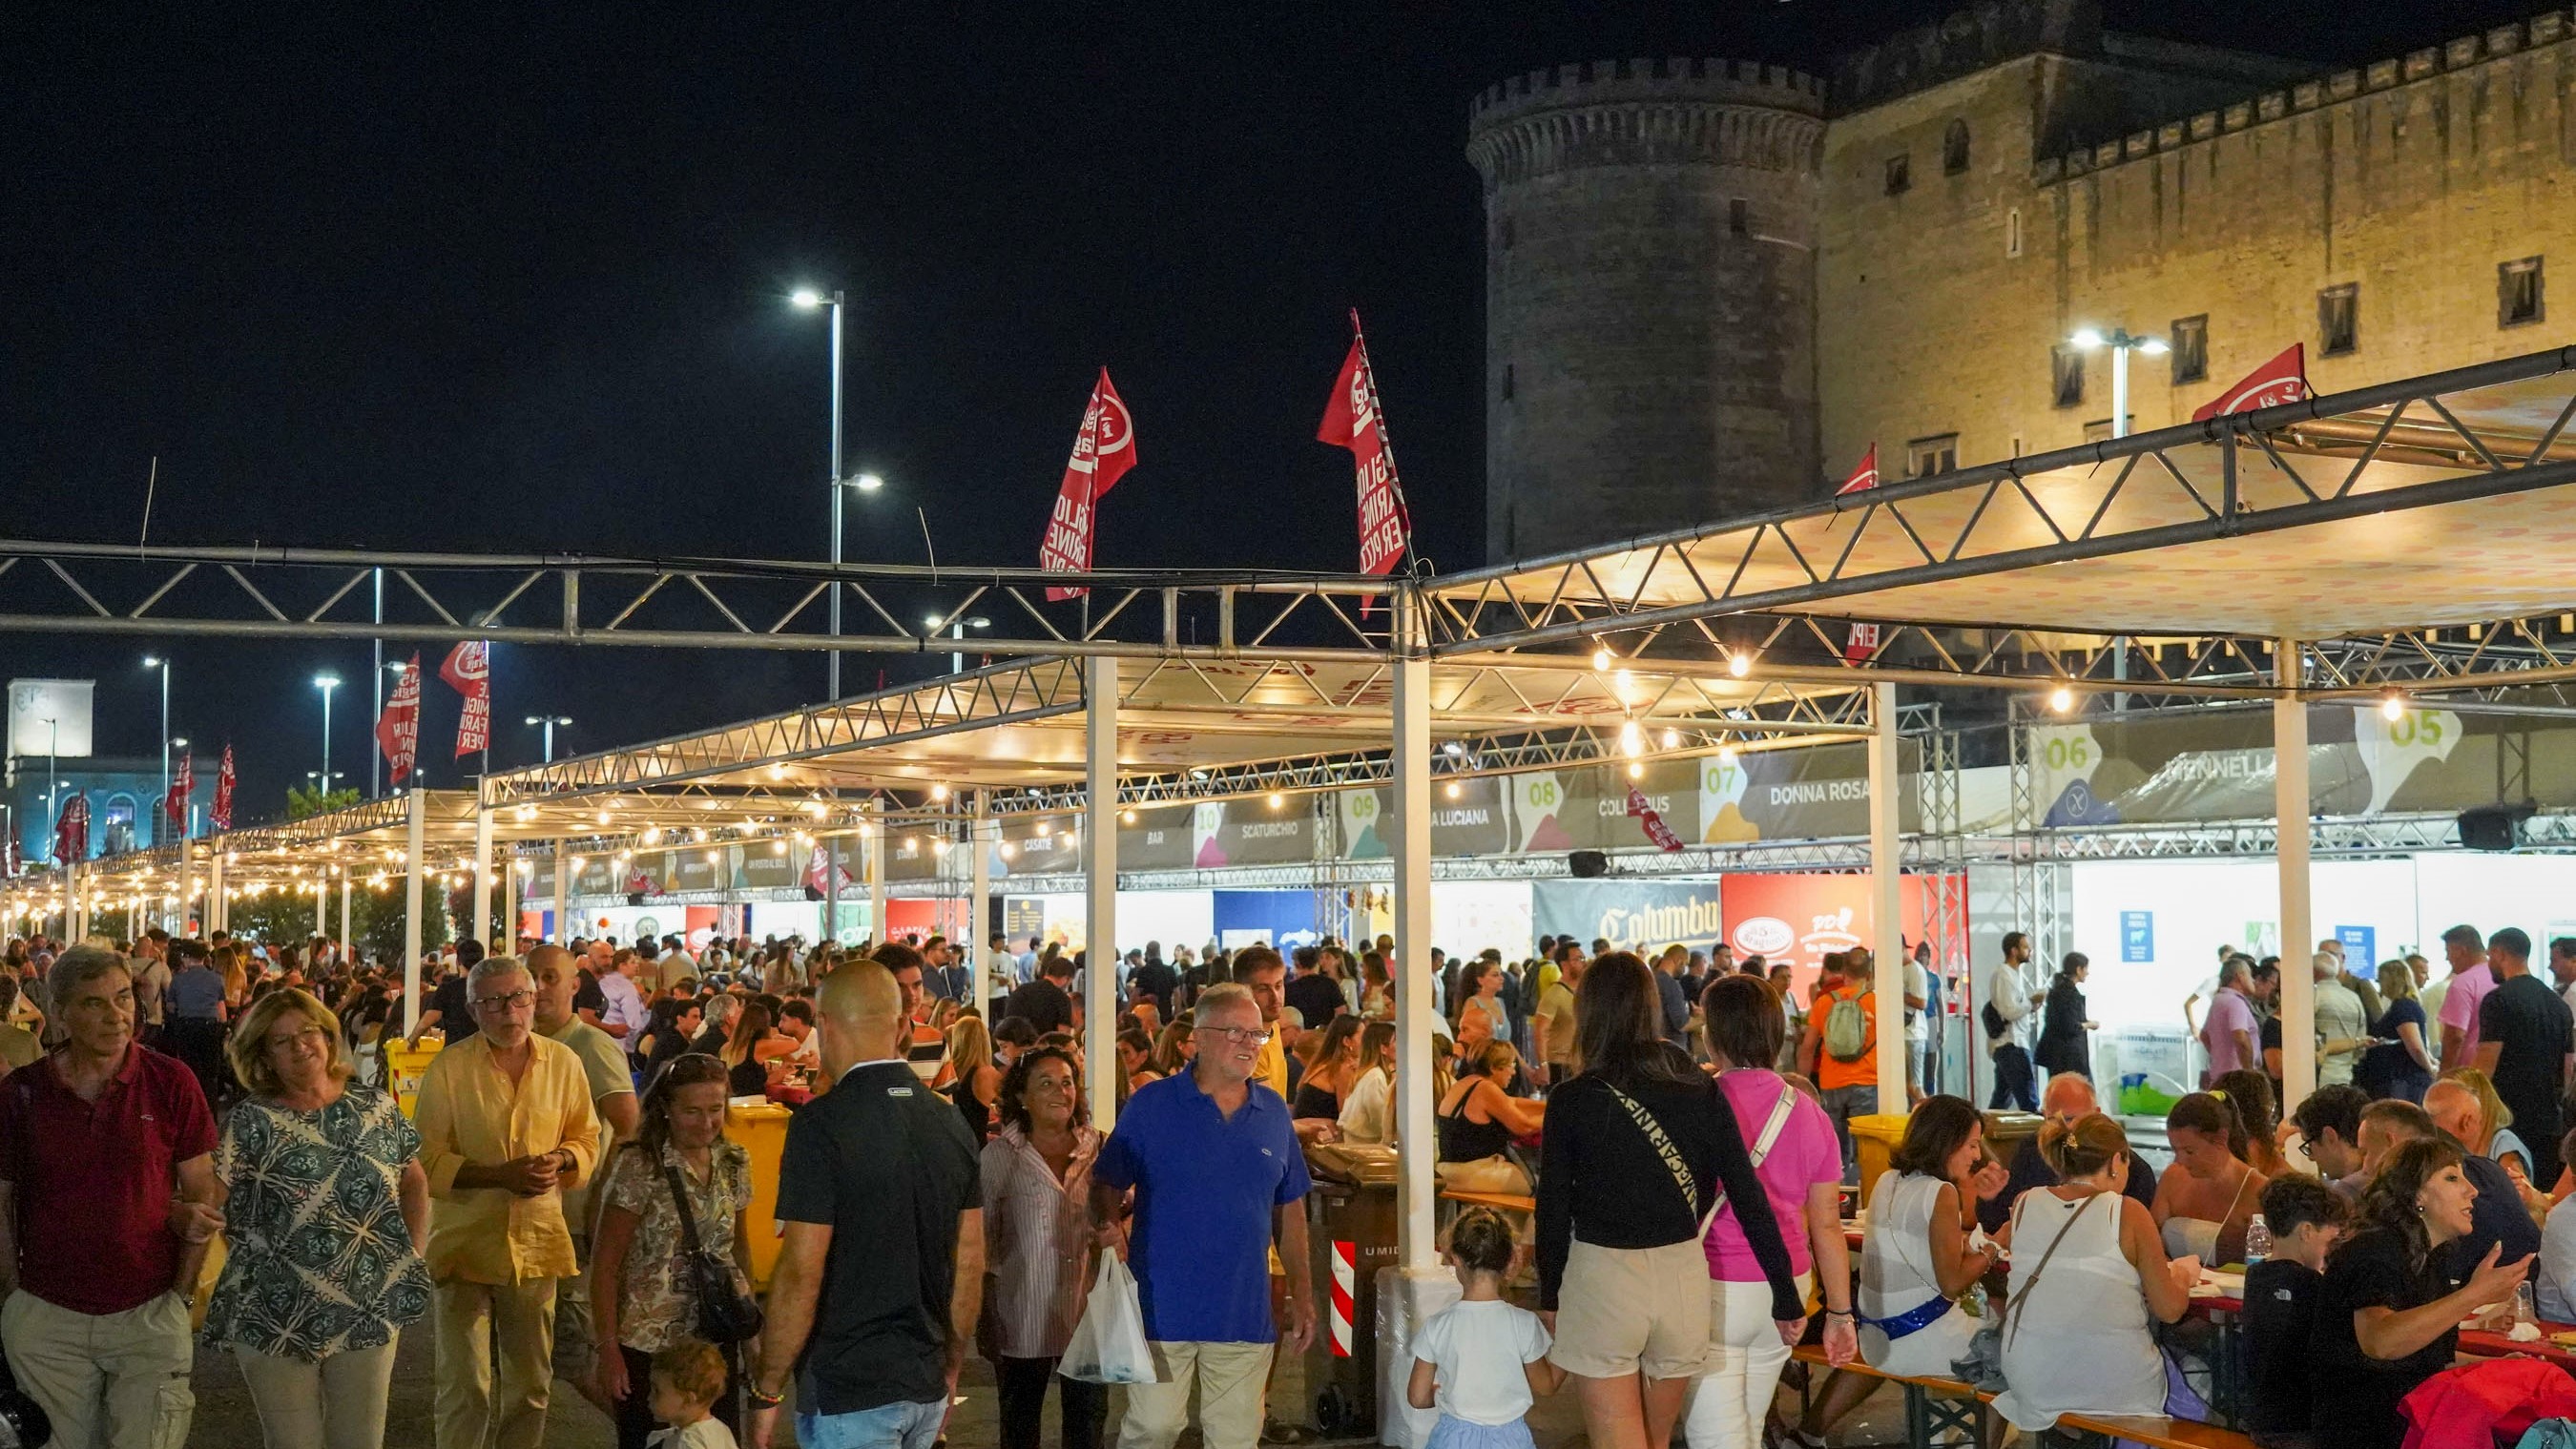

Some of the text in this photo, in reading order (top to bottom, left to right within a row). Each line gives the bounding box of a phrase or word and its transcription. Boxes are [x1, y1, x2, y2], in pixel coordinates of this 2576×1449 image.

[2390, 711, 2442, 747] 05
[2046, 736, 2088, 771] 06
[1706, 766, 1735, 795] 07
[1529, 780, 1555, 807] 08
[1770, 784, 1826, 806] DONNA
[1352, 795, 1374, 818] 09
[1441, 809, 1489, 826] LUCIANA
[1199, 812, 1215, 831] 10
[1242, 821, 1298, 838] SCATURCHIO
[1147, 831, 1164, 846] BAR
